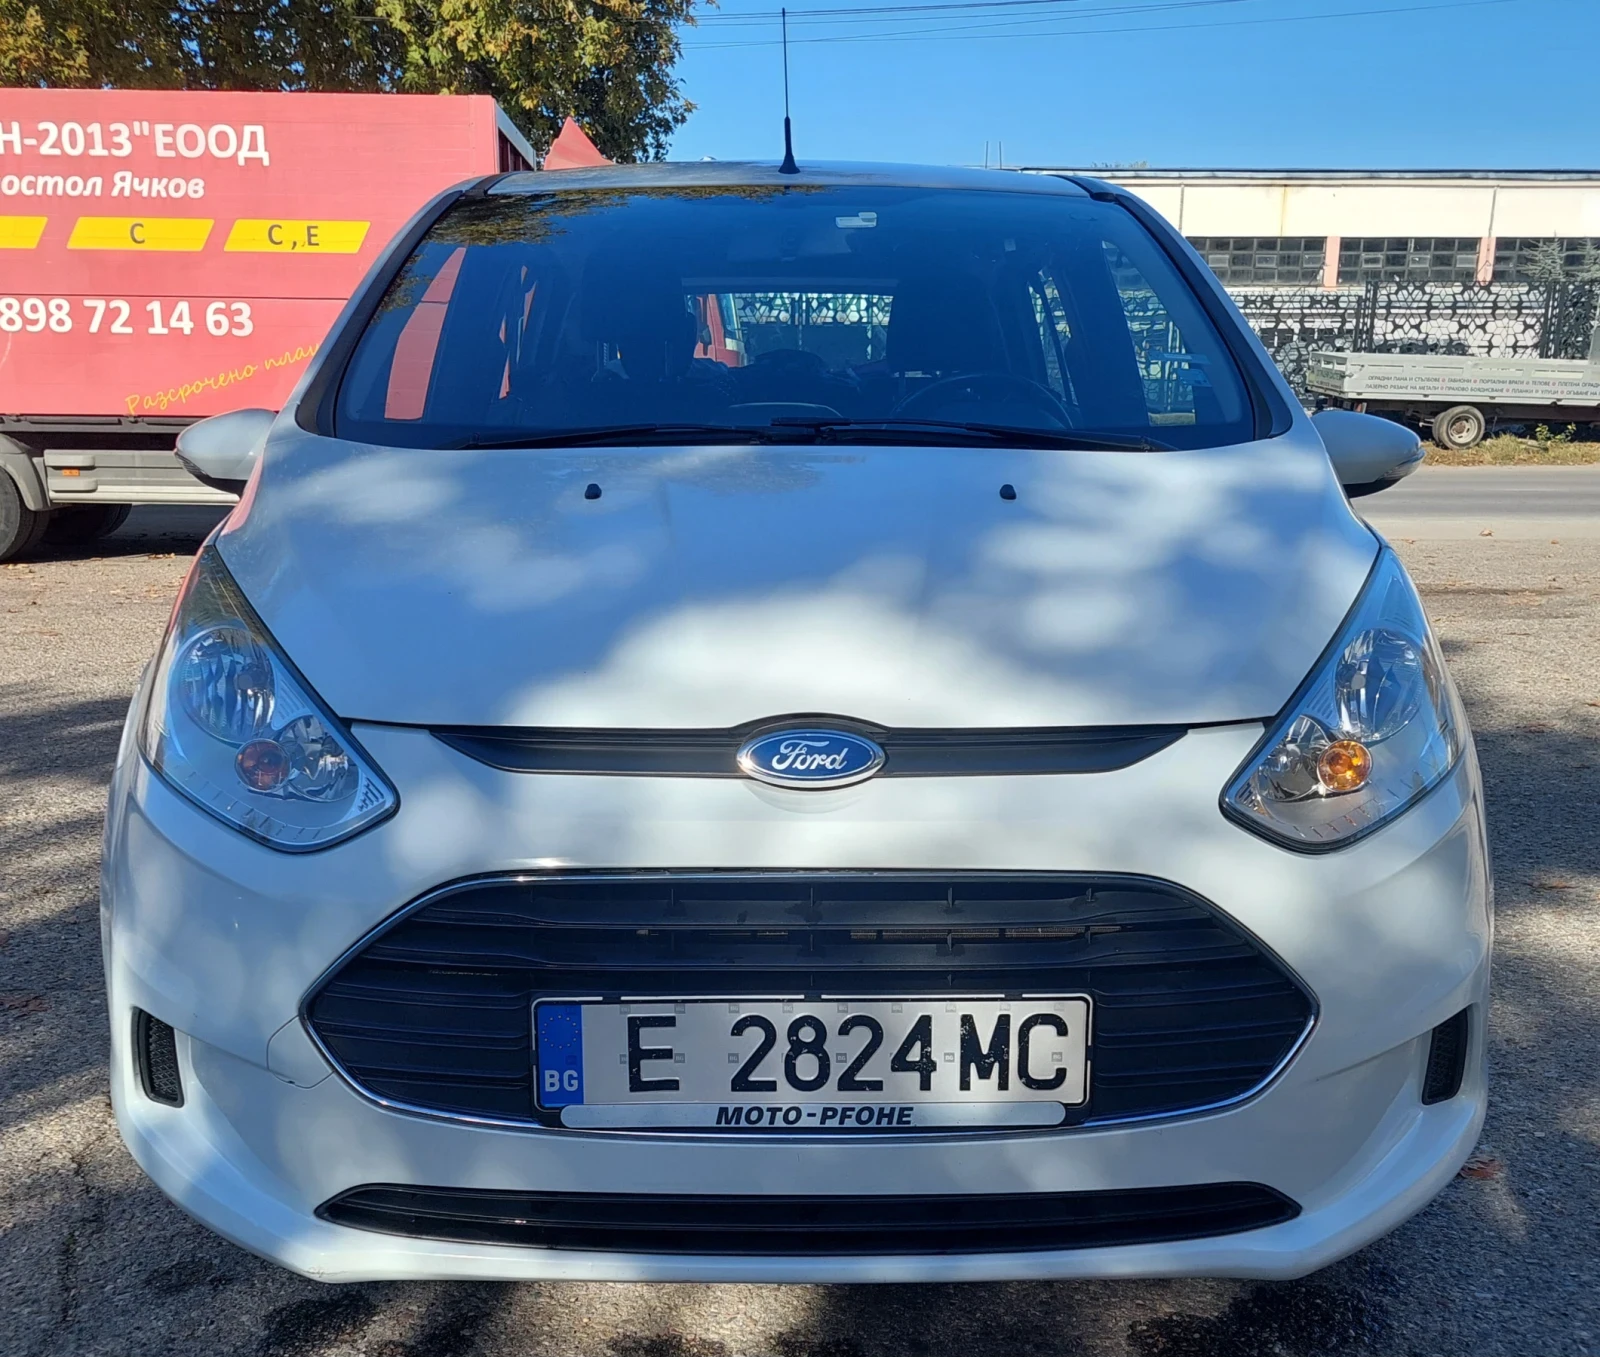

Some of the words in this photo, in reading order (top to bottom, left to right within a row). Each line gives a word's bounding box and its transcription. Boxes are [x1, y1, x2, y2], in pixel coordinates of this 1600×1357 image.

[111, 171, 206, 199] Ячков
[0, 297, 73, 333] 898
[83, 298, 133, 334] 72
[146, 300, 194, 336] 14
[205, 301, 254, 337] 63
[125, 364, 259, 415] Разсрочено
[771, 739, 849, 771] Ford
[544, 1069, 579, 1092] BG
[627, 1014, 680, 1093] E
[730, 1013, 937, 1093] 2824
[959, 1013, 1069, 1092] MC
[715, 1106, 914, 1126] MOTO-PFOHE
